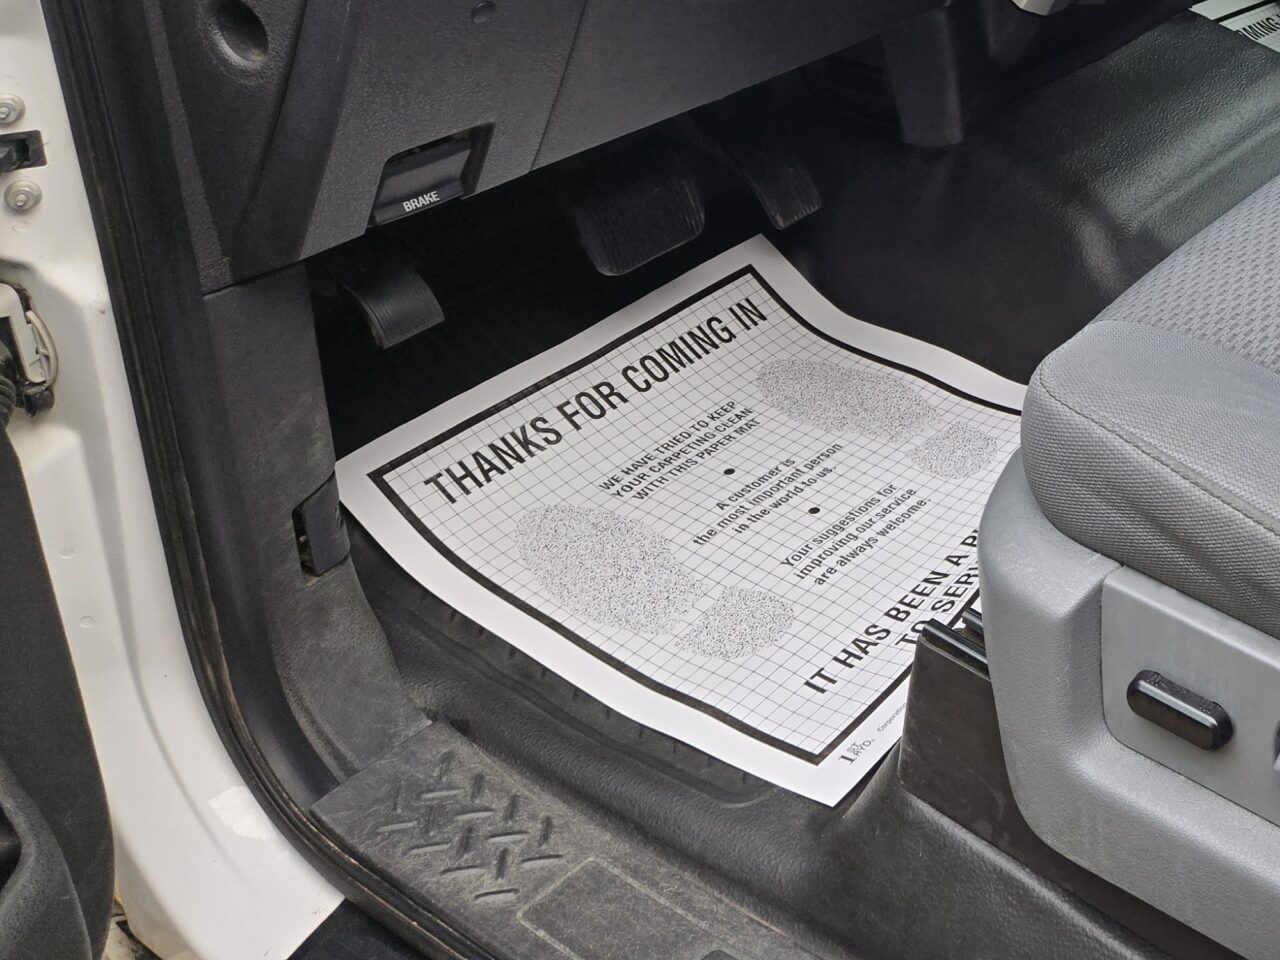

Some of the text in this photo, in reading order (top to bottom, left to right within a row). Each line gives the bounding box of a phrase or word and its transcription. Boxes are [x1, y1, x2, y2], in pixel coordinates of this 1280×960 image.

[402, 190, 440, 212] BRAKE
[424, 297, 768, 504] THANKS FOR COMING IN
[599, 401, 736, 491] WE HAVE TRIED TO KEEP
[612, 407, 753, 499] YOUR CARPETING CLEAN
[632, 418, 761, 501] WITH THIS PAPER MAT
[716, 457, 796, 511] A customer is
[693, 443, 843, 546] the most important person
[732, 466, 837, 534] in the world to us.
[781, 483, 898, 568] Your suggestions for
[793, 489, 917, 581] improving our service
[814, 498, 932, 586] are always welcome.
[804, 667, 838, 694] IT
[832, 623, 891, 669] HAS
[884, 570, 950, 623] BEEN
[944, 553, 969, 567] A
[931, 562, 978, 613] SER
